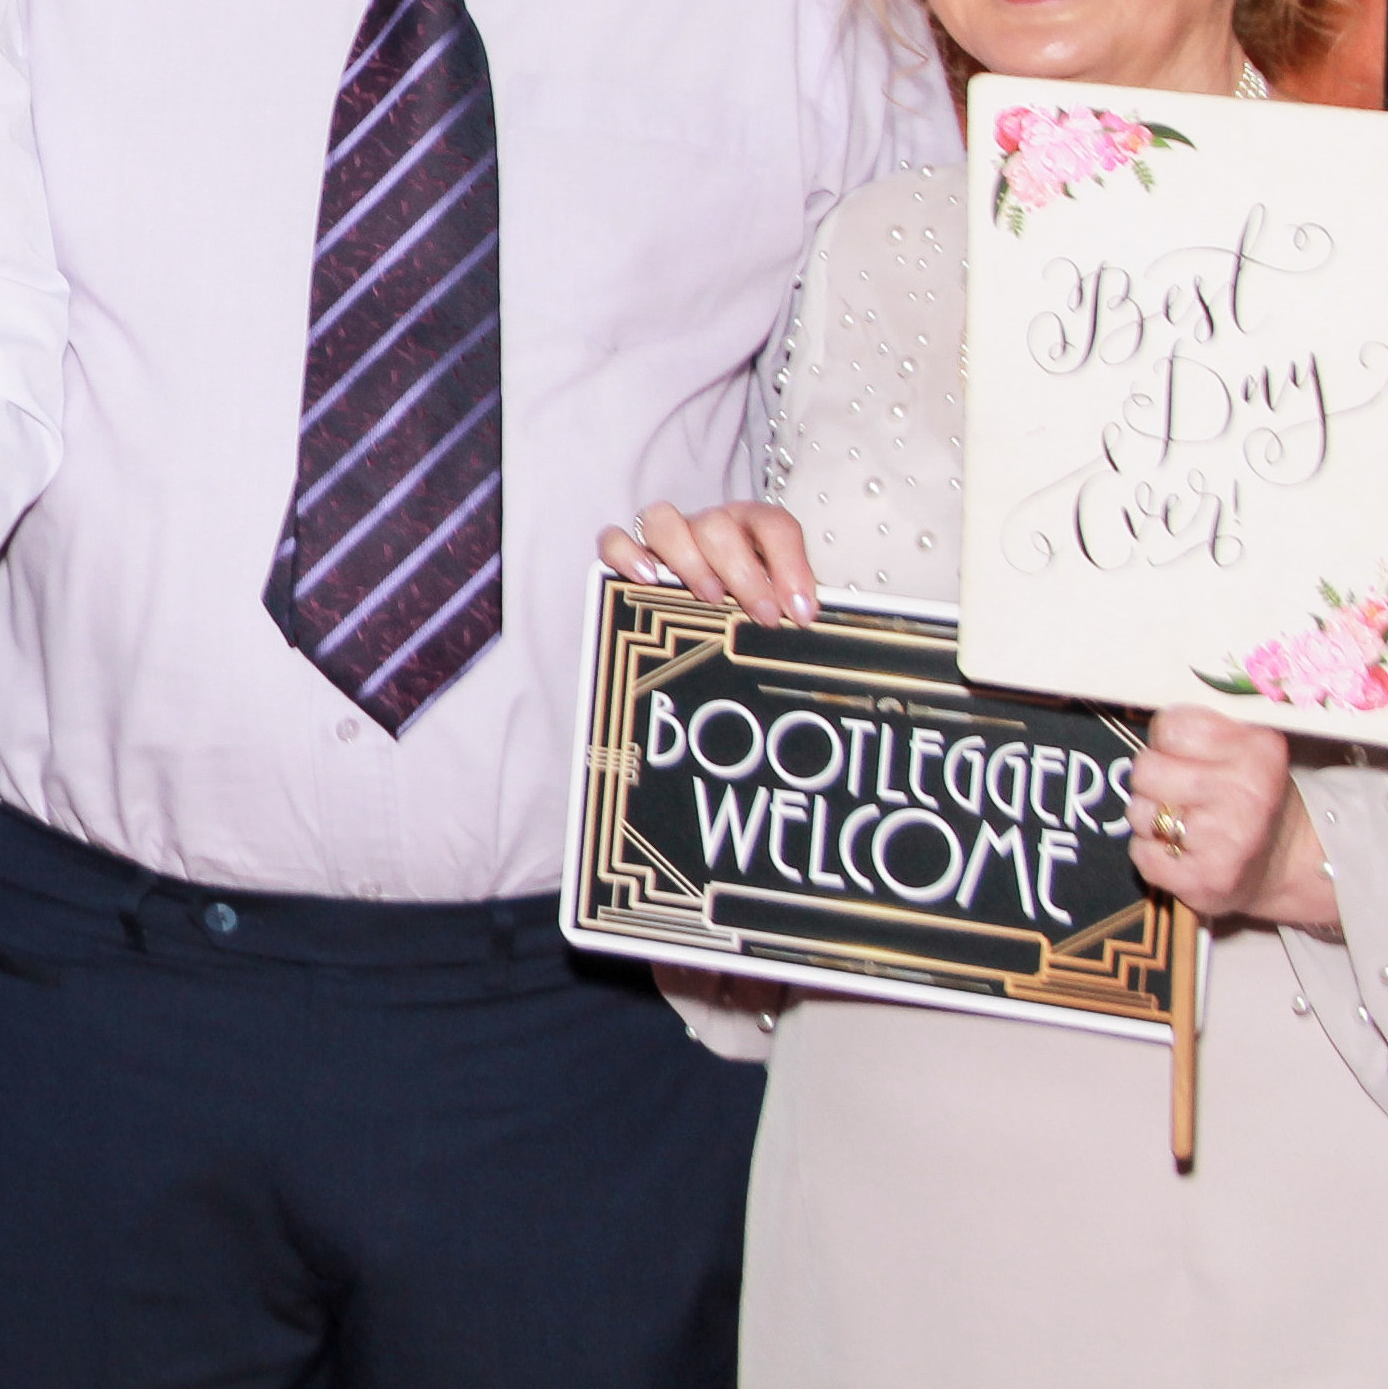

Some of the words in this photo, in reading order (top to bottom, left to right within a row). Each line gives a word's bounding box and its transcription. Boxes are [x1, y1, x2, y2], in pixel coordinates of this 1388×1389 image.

[1027, 203, 1334, 376] Best
[1123, 338, 1388, 486] Day
[1000, 422, 1245, 574] Ever!
[645, 690, 1133, 839] BOOTLEGGERS
[691, 774, 1081, 926] WELCOME
